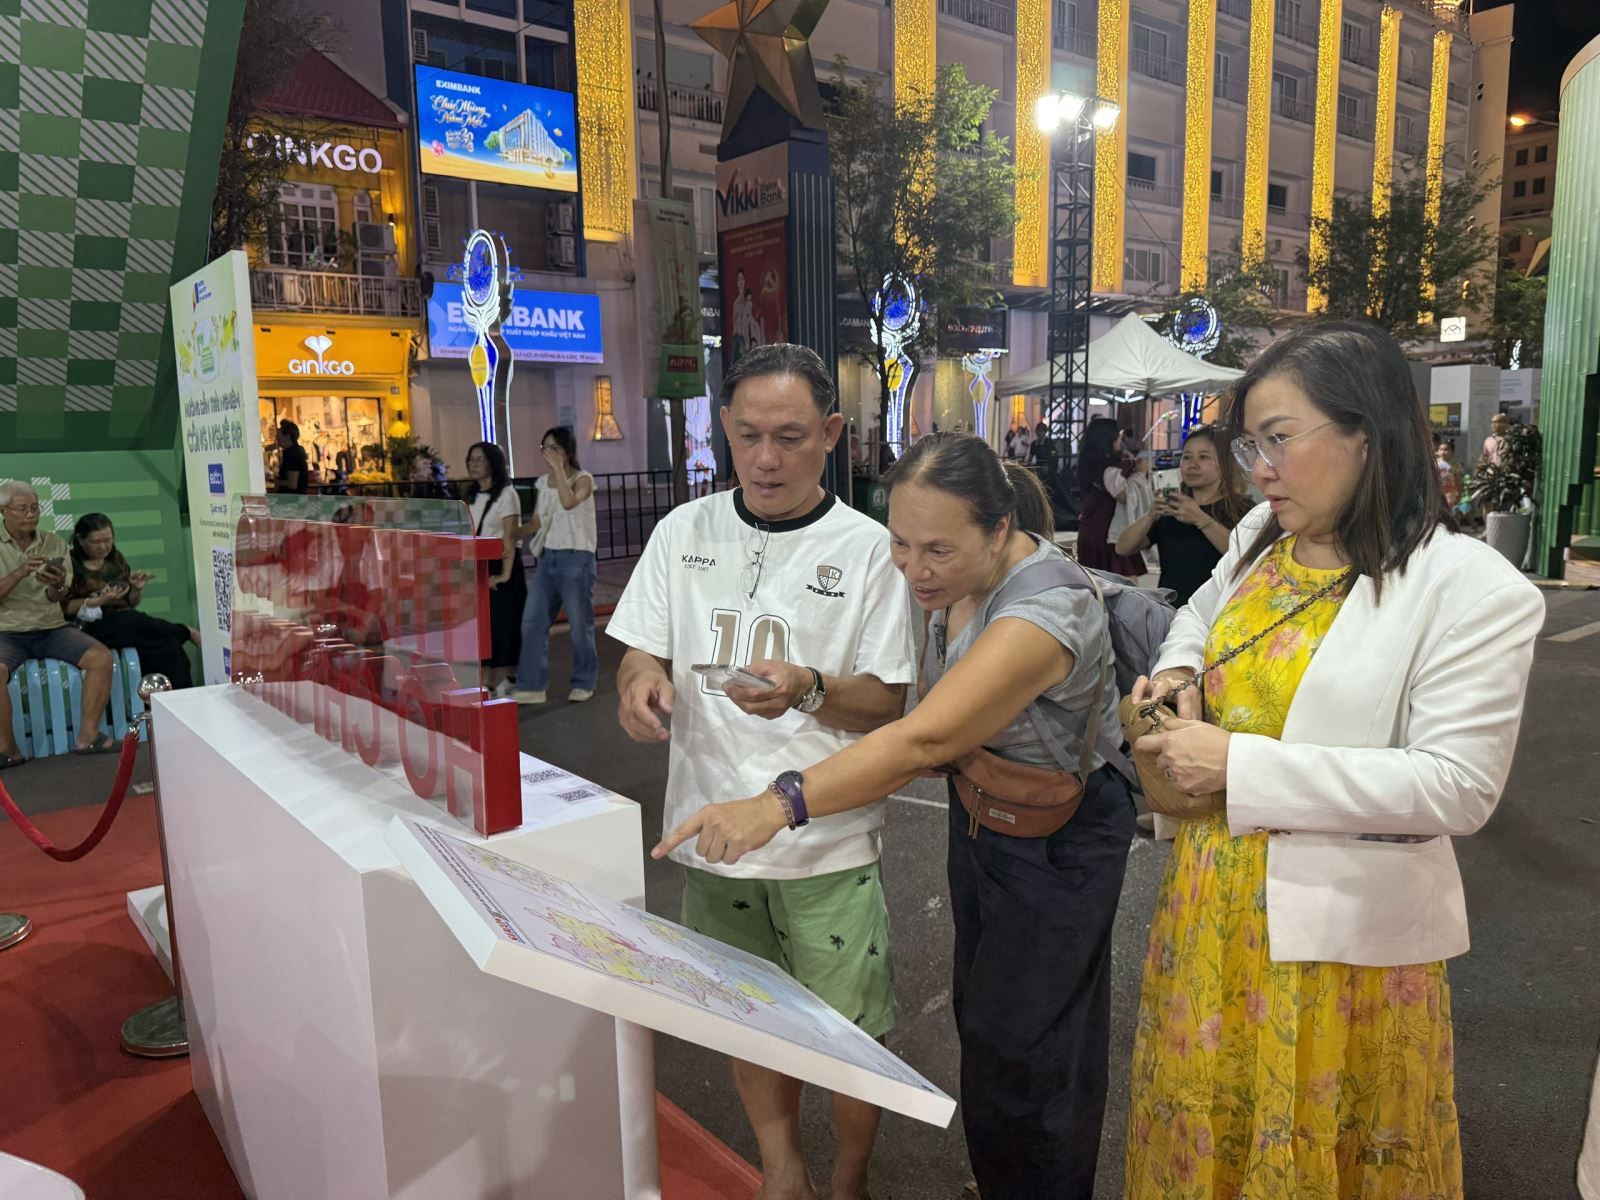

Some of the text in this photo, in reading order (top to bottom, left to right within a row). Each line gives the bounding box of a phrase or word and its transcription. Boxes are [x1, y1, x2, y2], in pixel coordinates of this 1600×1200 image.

[436, 79, 481, 95] EXIMBANK
[246, 132, 383, 174] GINKGO
[716, 168, 760, 216] Vikki
[761, 188, 783, 205] Bank
[447, 301, 585, 331] EBANK
[681, 554, 716, 567] KAPPA
